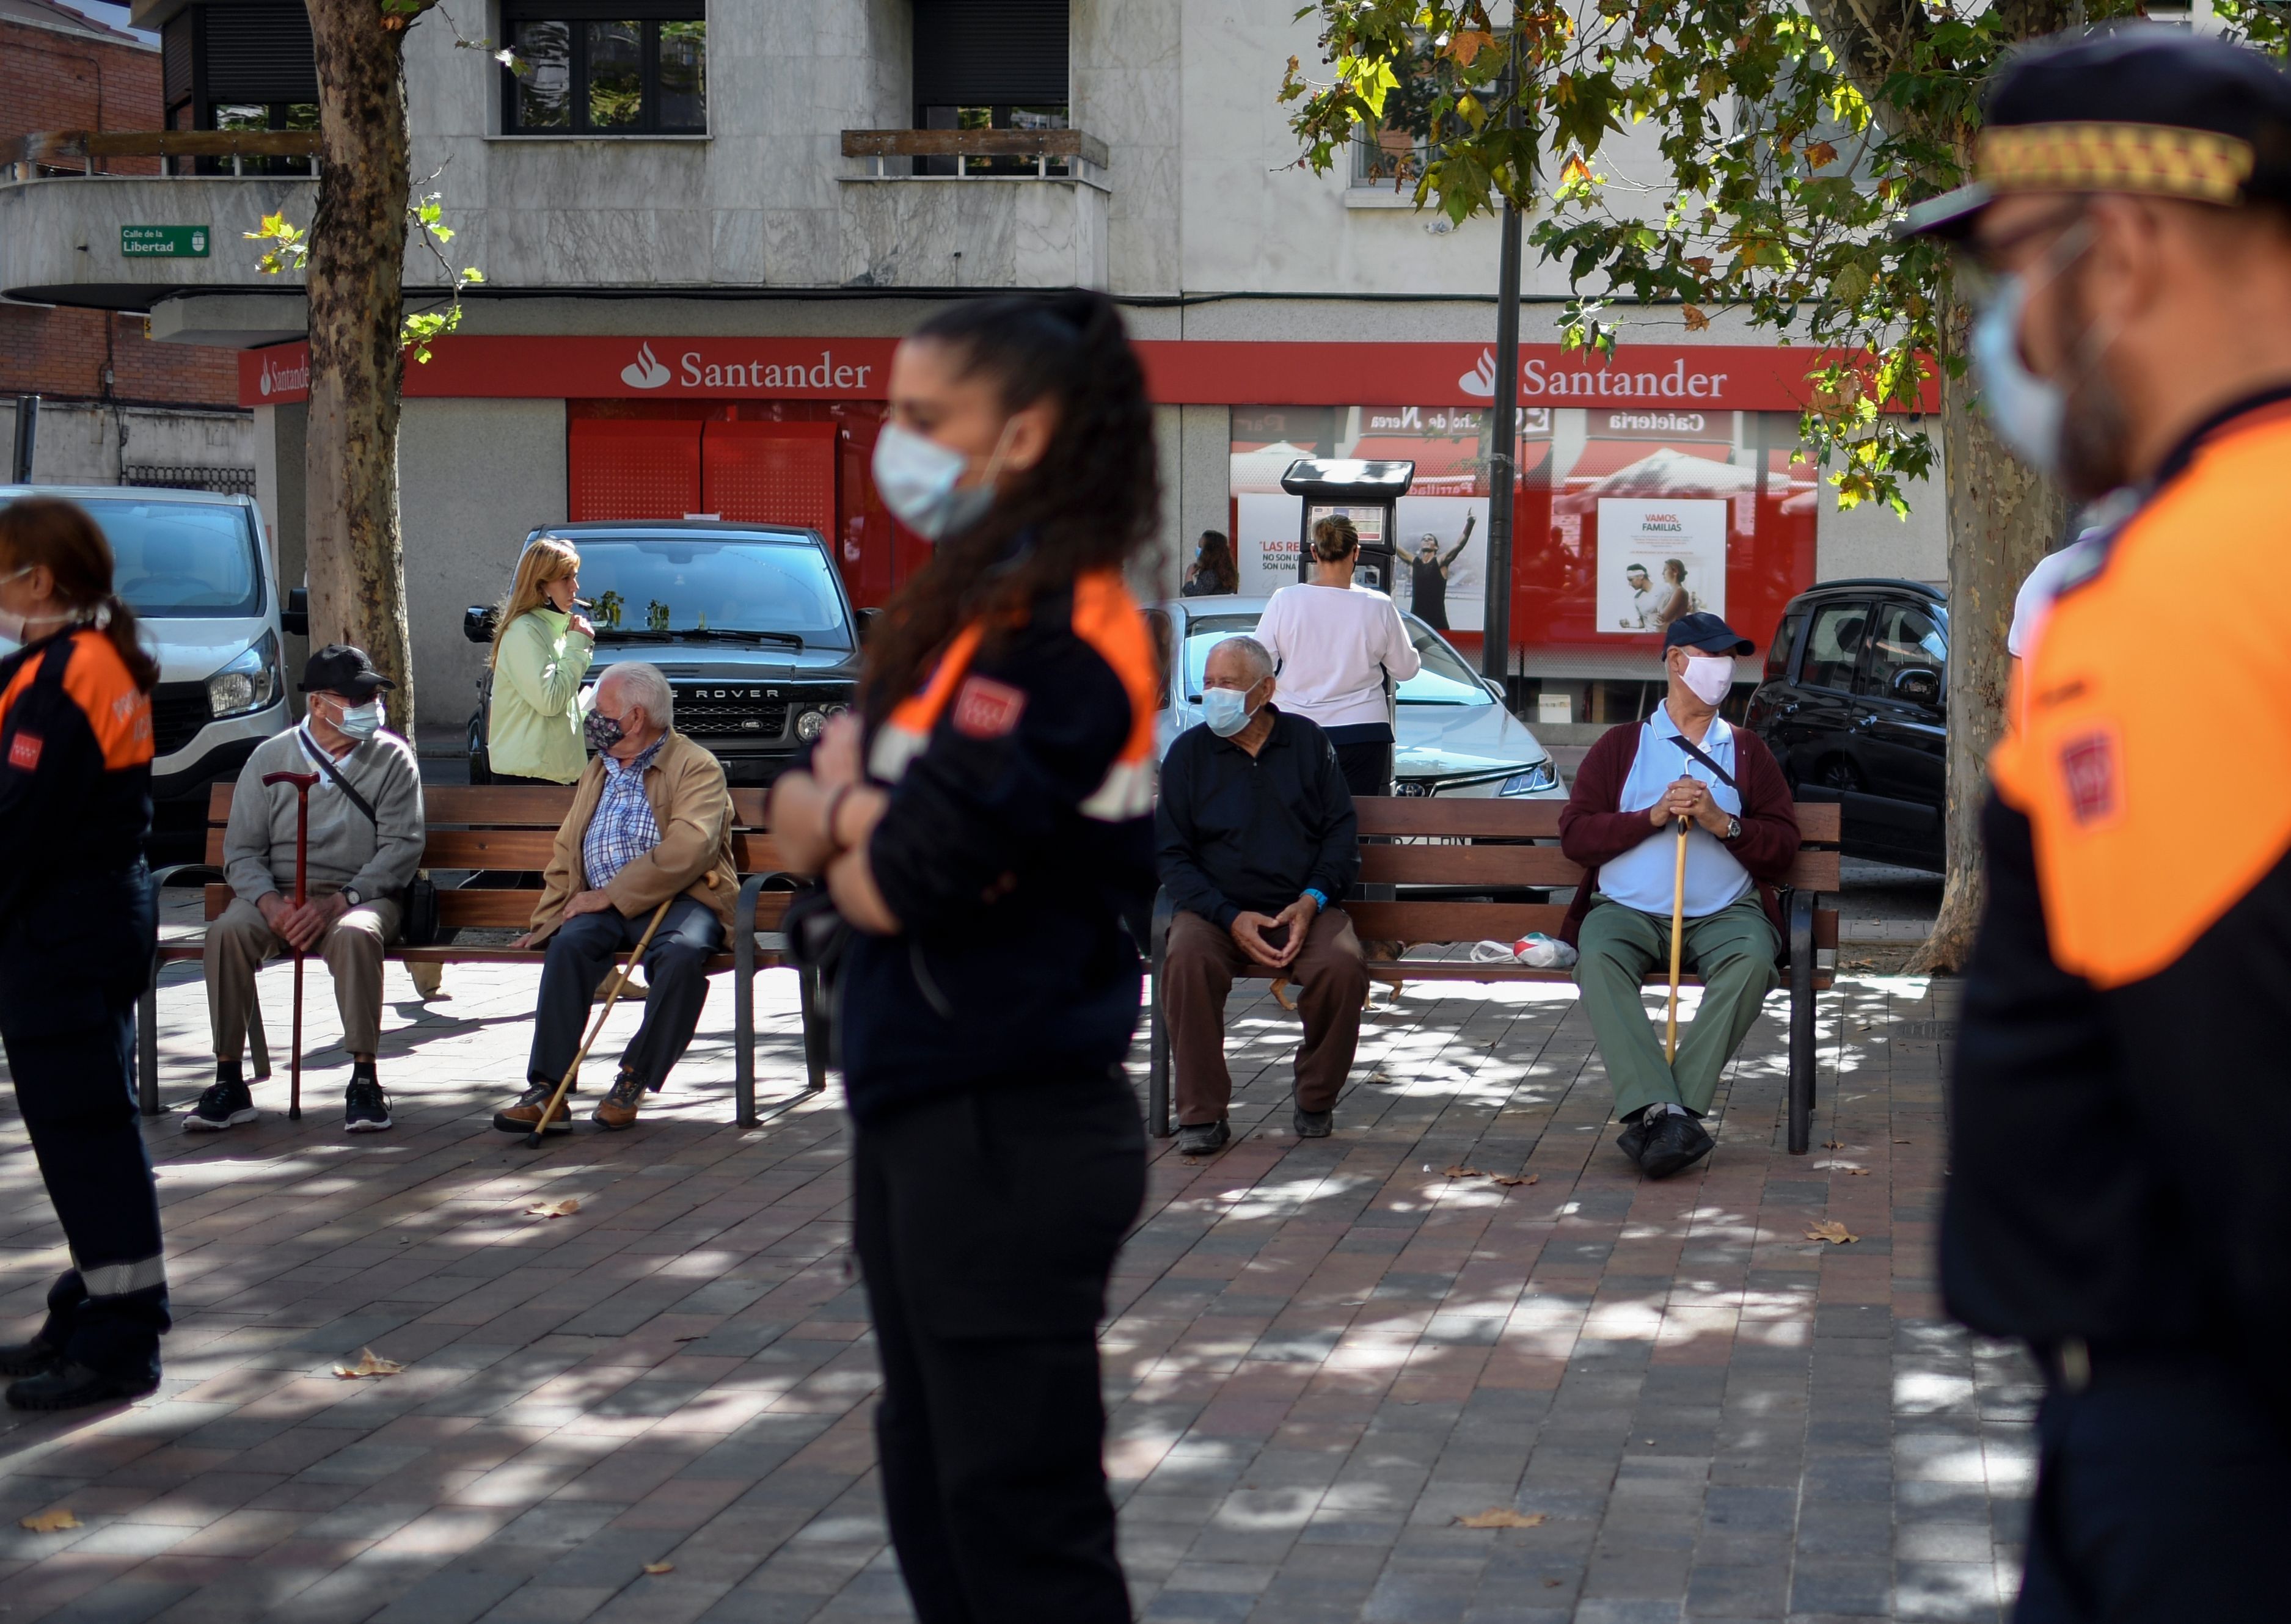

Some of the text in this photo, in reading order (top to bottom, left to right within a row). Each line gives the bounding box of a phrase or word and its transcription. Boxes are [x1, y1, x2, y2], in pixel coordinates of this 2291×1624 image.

[123, 241, 174, 252] Libertad
[272, 354, 310, 393] Santande
[681, 351, 871, 388] Santander
[1523, 358, 1728, 397] Santander
[1645, 514, 1679, 523] VAMOS,
[1286, 542, 1299, 552] RE
[695, 690, 779, 698] ROVER
